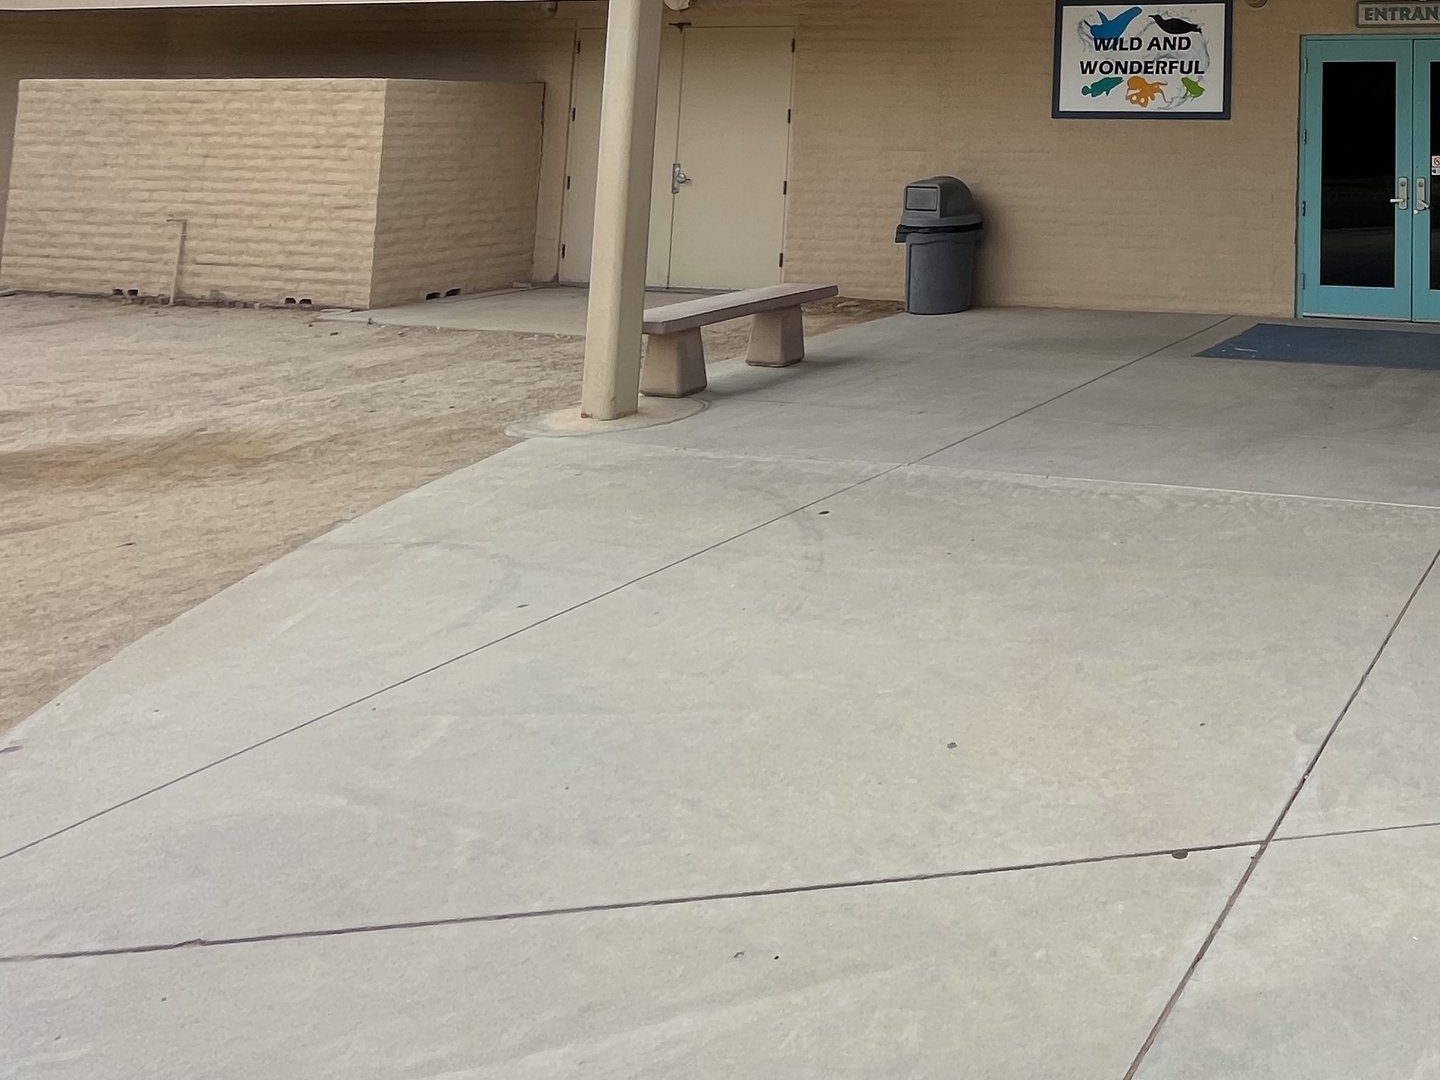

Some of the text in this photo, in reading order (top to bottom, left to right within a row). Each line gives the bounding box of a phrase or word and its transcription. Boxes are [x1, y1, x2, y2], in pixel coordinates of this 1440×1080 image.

[1093, 36, 1192, 51] WILD AND
[1080, 60, 1205, 75] WONDERFUL
